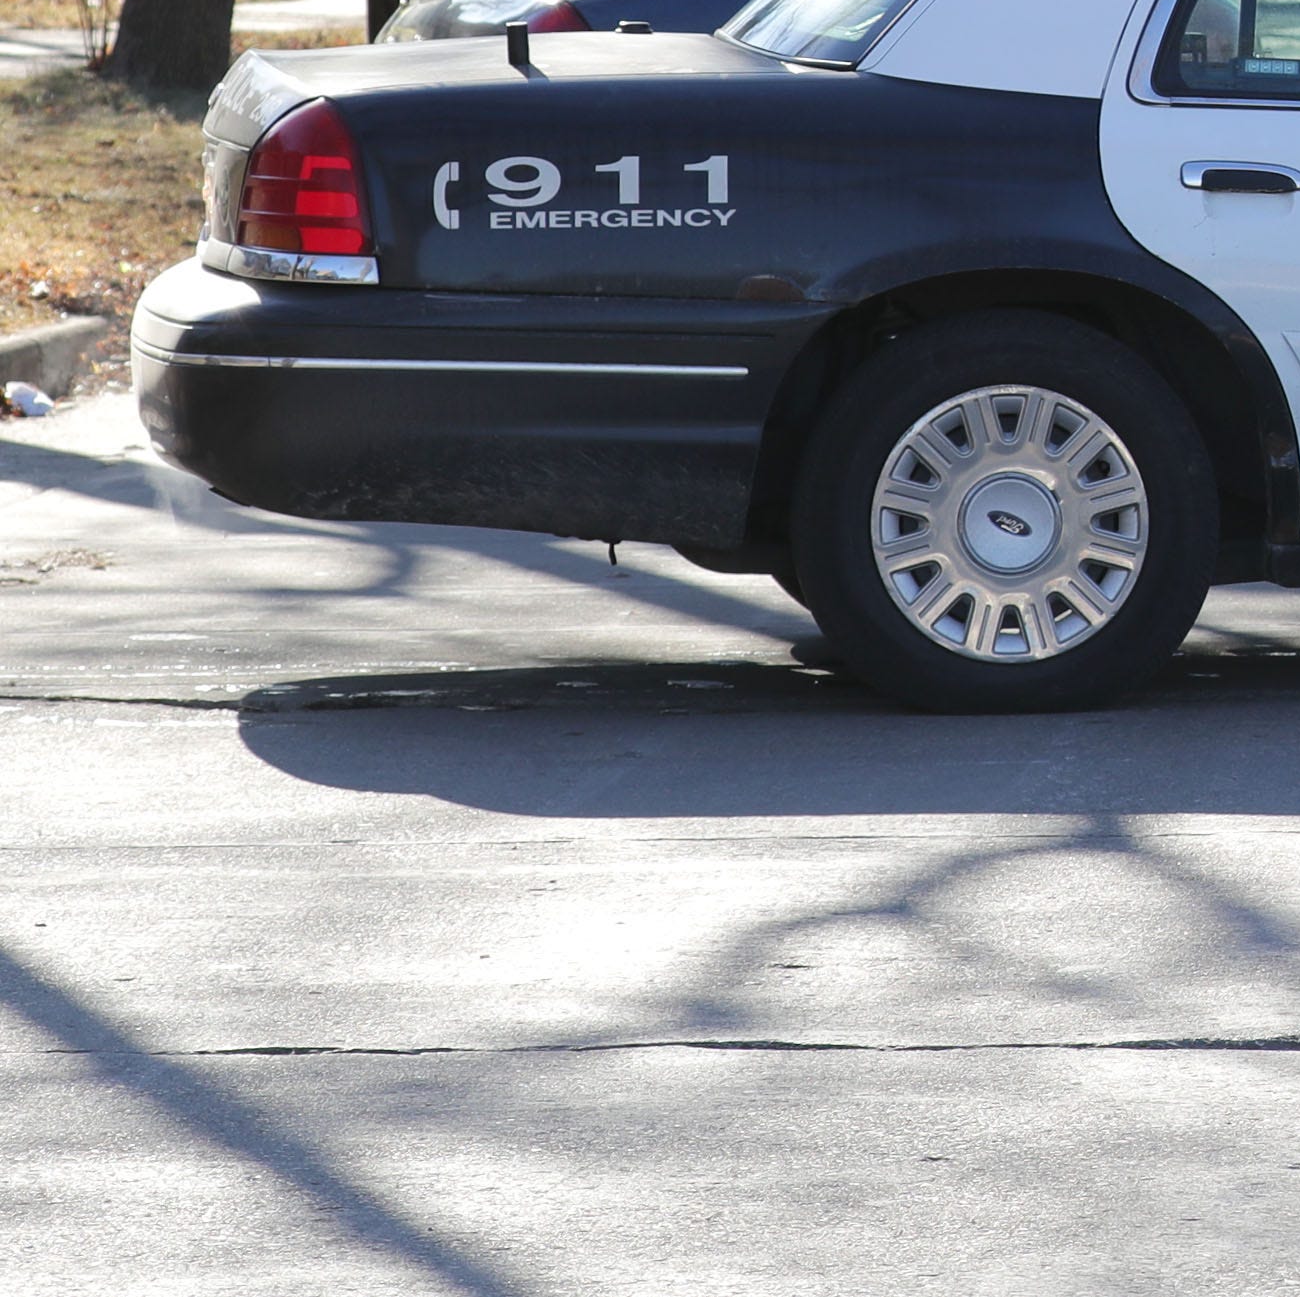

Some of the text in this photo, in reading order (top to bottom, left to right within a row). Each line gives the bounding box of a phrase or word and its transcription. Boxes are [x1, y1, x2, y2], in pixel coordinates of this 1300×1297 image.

[484, 155, 729, 208] 911
[489, 208, 737, 230] EMERGENCY
[996, 515, 1025, 534] Ford
